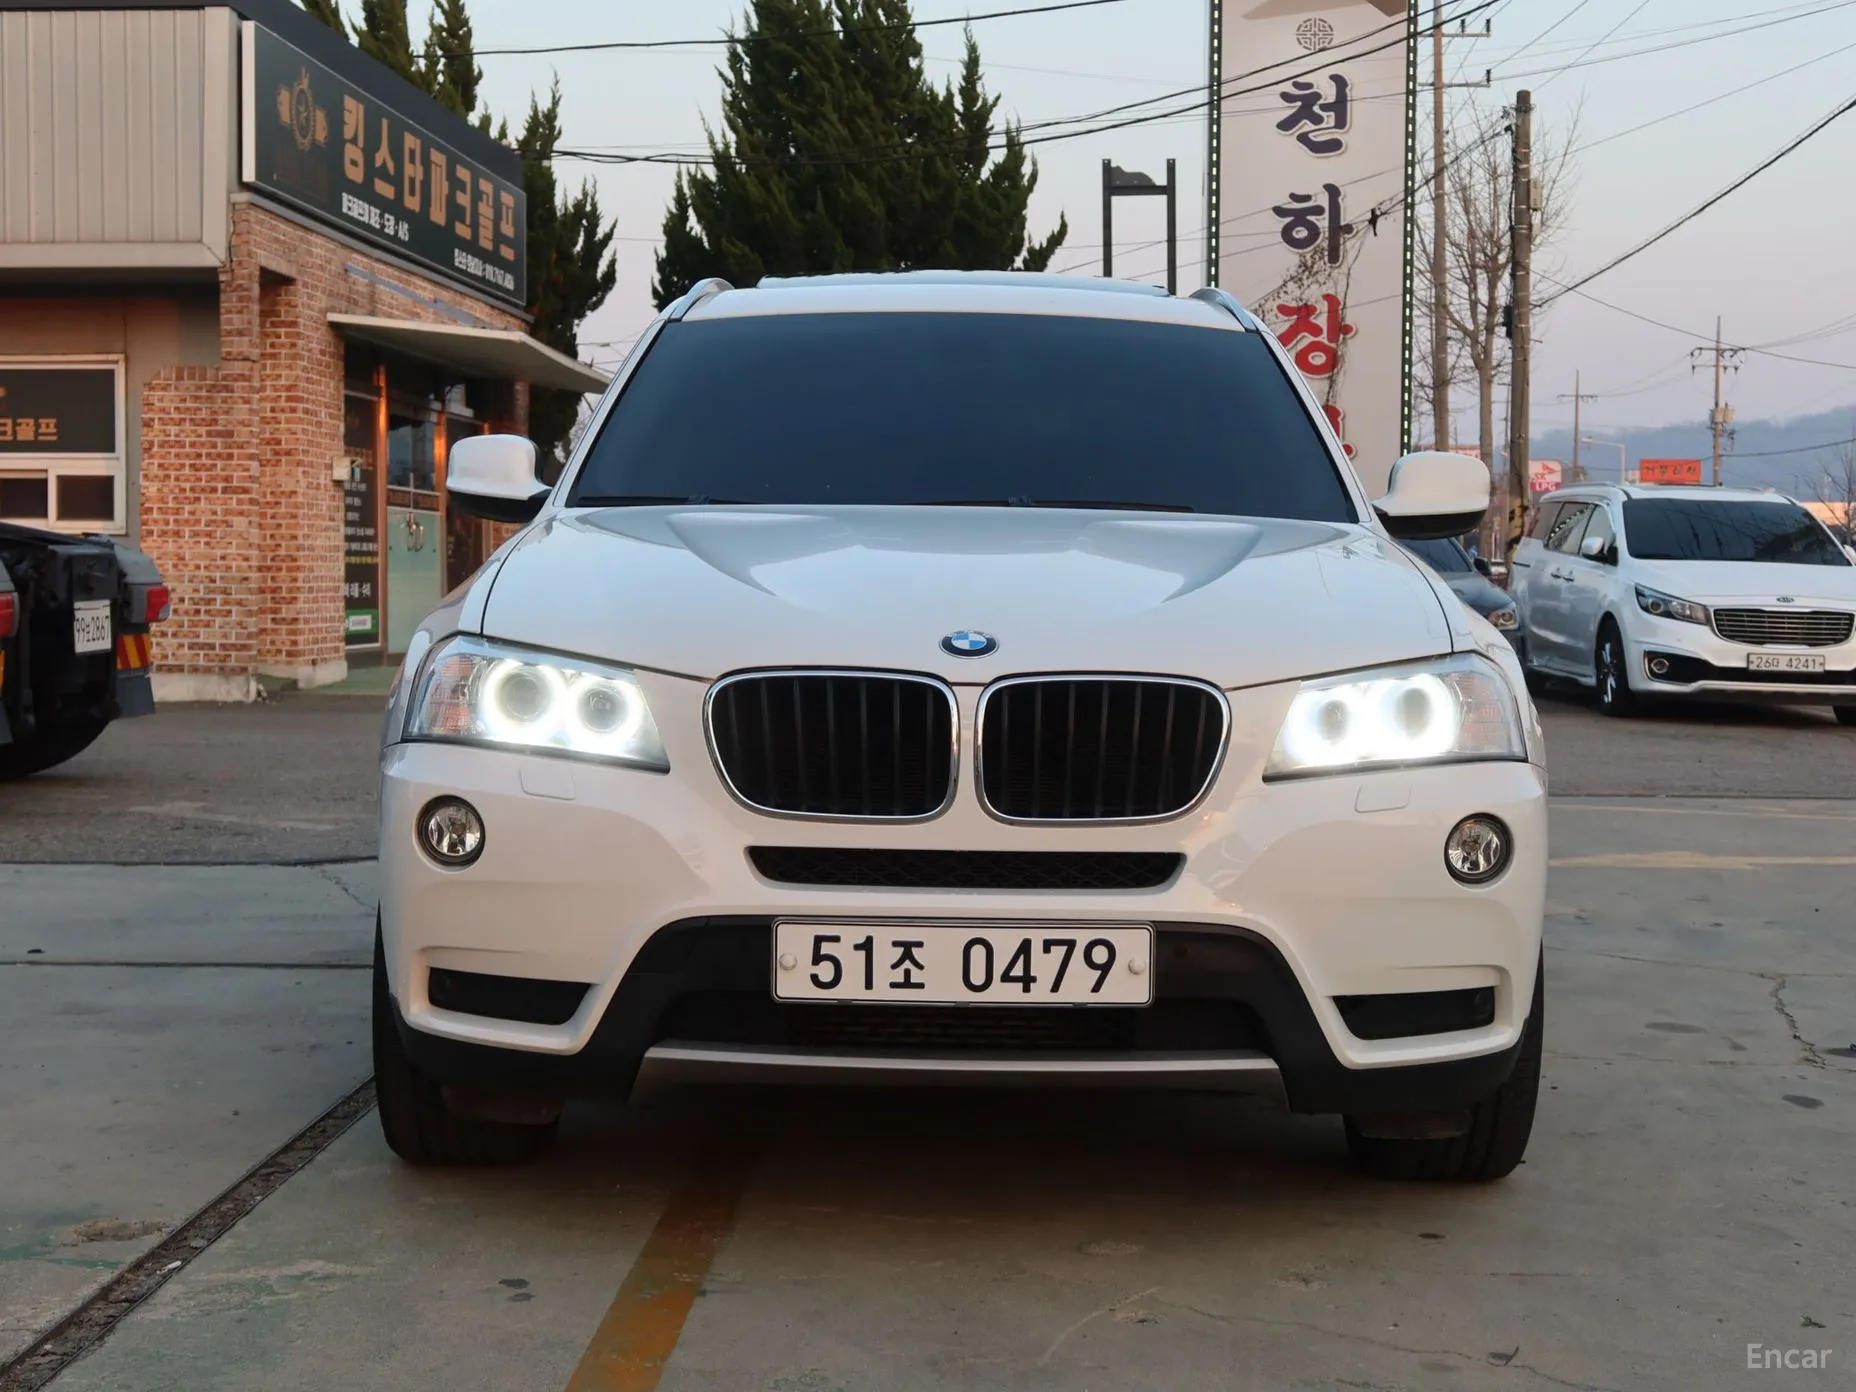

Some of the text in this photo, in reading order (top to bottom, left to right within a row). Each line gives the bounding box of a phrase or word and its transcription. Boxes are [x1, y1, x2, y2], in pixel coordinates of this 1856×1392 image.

[343, 94, 516, 262] 킹스타파크골프
[1786, 657, 1817, 670] 4241
[809, 934, 1117, 993] 51조 0479
